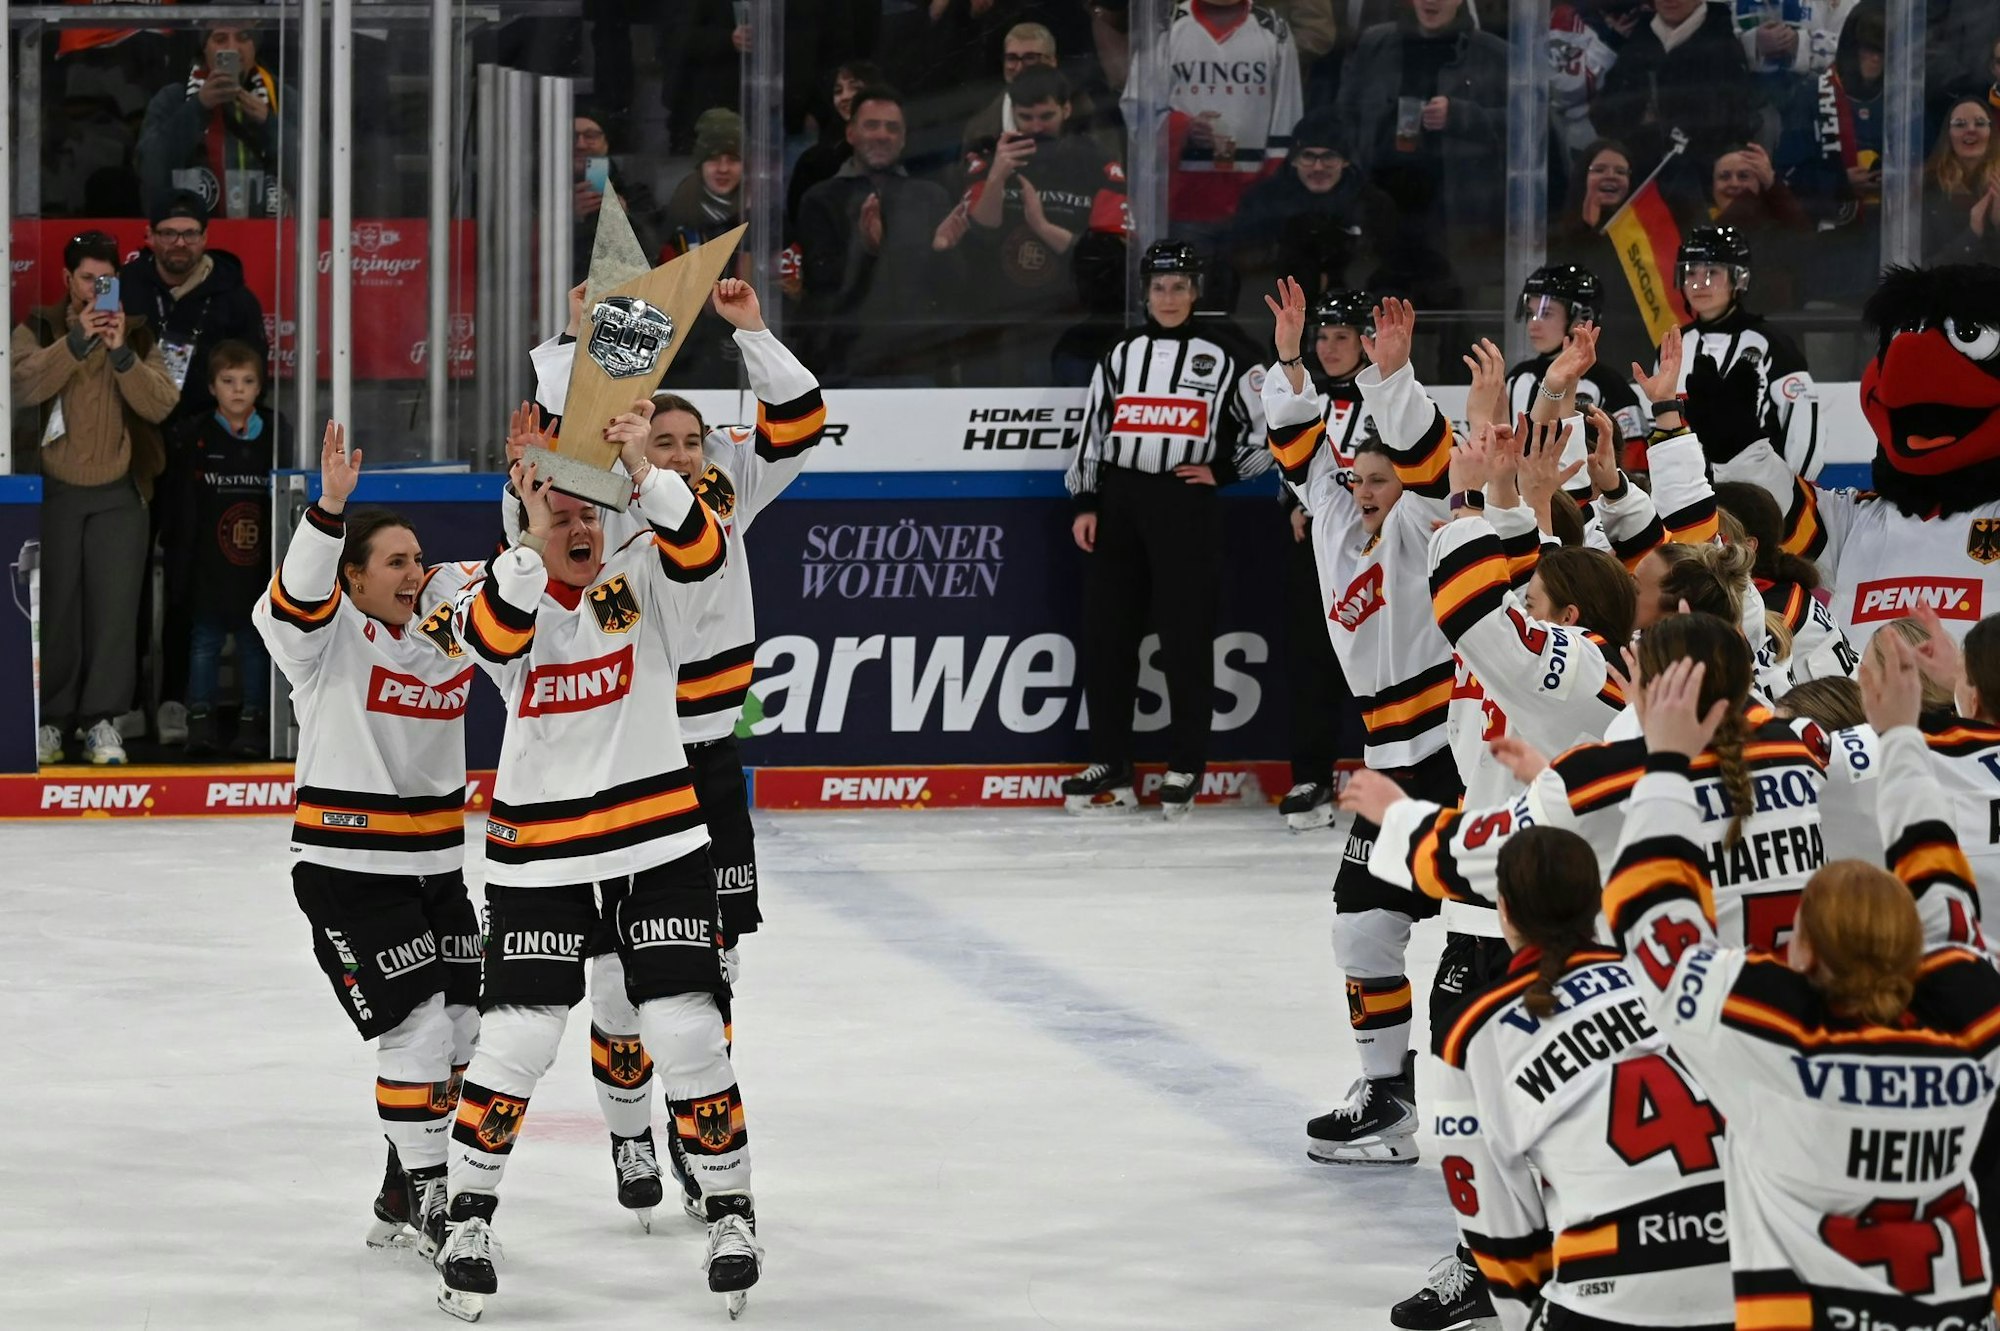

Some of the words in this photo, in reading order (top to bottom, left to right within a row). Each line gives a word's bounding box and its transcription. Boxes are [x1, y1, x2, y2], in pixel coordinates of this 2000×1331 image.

[1171, 60, 1267, 84] WINGS
[596, 319, 659, 354] CUP
[969, 408, 1054, 422] HOME
[1064, 408, 1085, 422] O
[963, 428, 1081, 450] HOCK
[802, 518, 1004, 561] SCHÖNER
[801, 562, 1004, 599] WOHNEN
[206, 782, 295, 807] PENN
[981, 776, 1064, 799] PENN
[1141, 773, 1245, 798] PNY
[503, 930, 585, 956] CINQUE
[629, 917, 711, 944] CINQUE
[375, 929, 437, 975] CINQU
[1515, 996, 1659, 1105] WEICHE
[1606, 1053, 1725, 1177] 4
[1441, 1155, 1481, 1218] 6
[1637, 1210, 1730, 1246] Ring
[1817, 1181, 1987, 1296] 41
